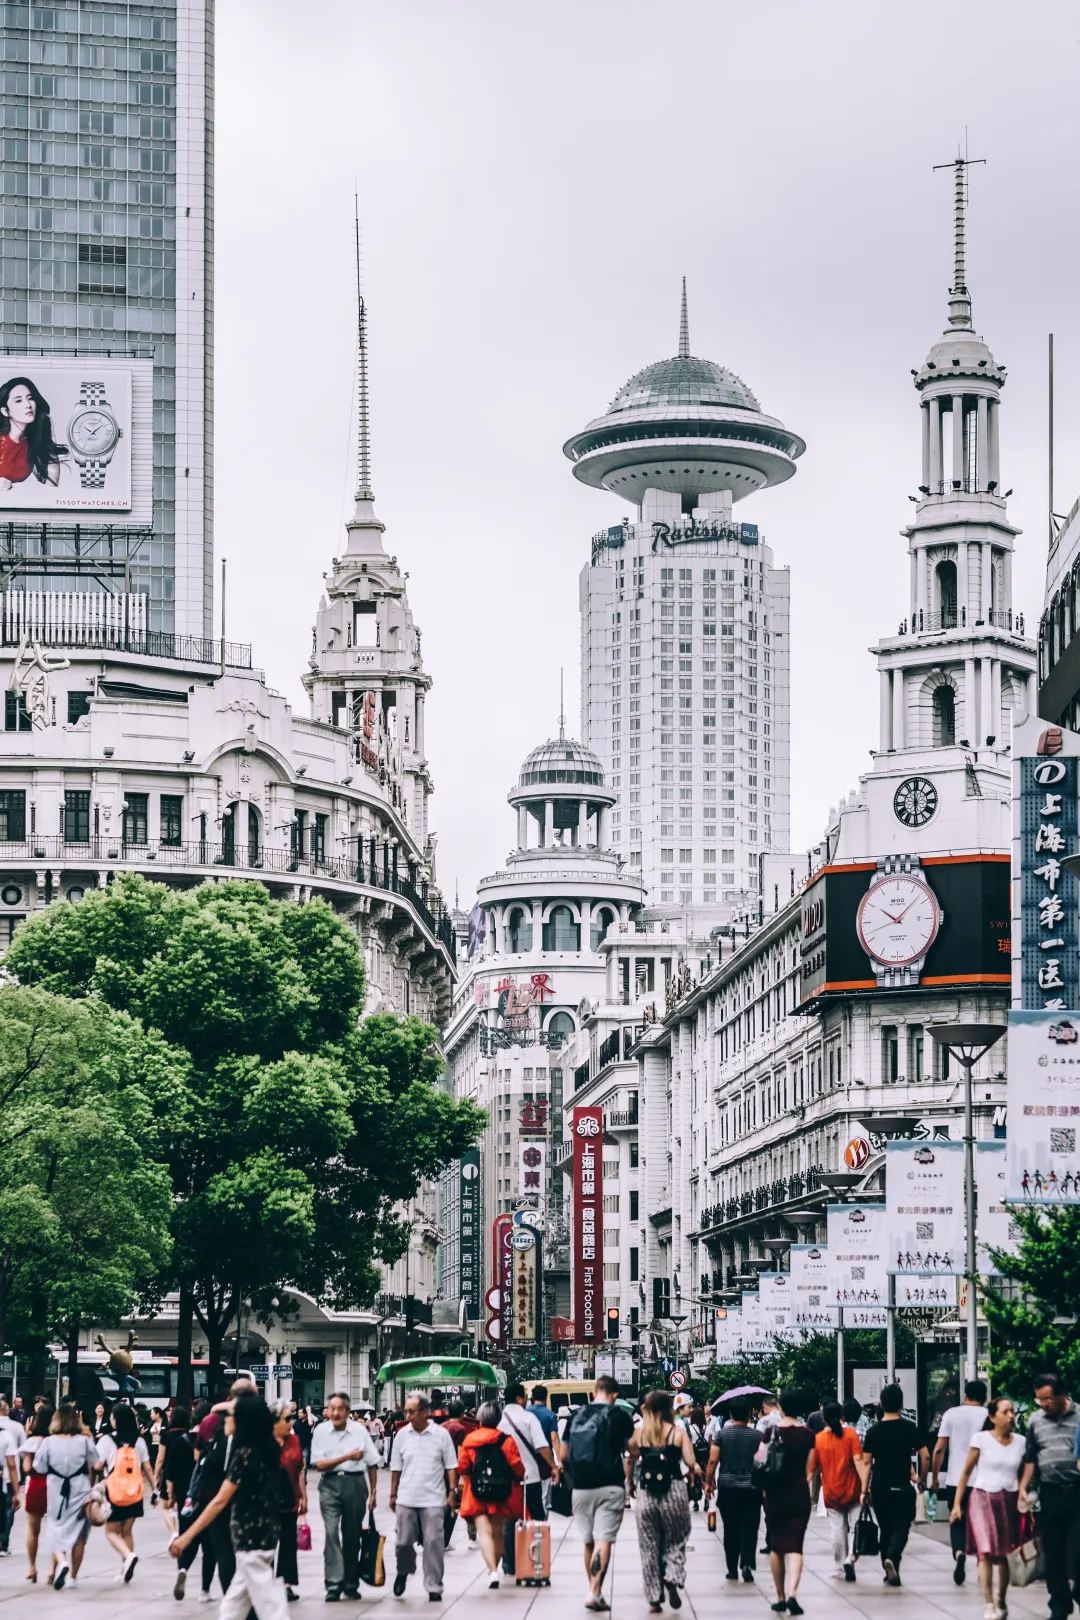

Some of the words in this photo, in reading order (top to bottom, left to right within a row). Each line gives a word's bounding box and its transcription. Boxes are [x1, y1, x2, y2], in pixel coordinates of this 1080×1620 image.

[652, 516, 739, 552] Radisson
[581, 1142, 596, 1261] 上海市第一食品商店
[462, 1185, 473, 1305] 上海市第一百货商店
[584, 1266, 594, 1288] First
[584, 1290, 594, 1337] Foodhall
